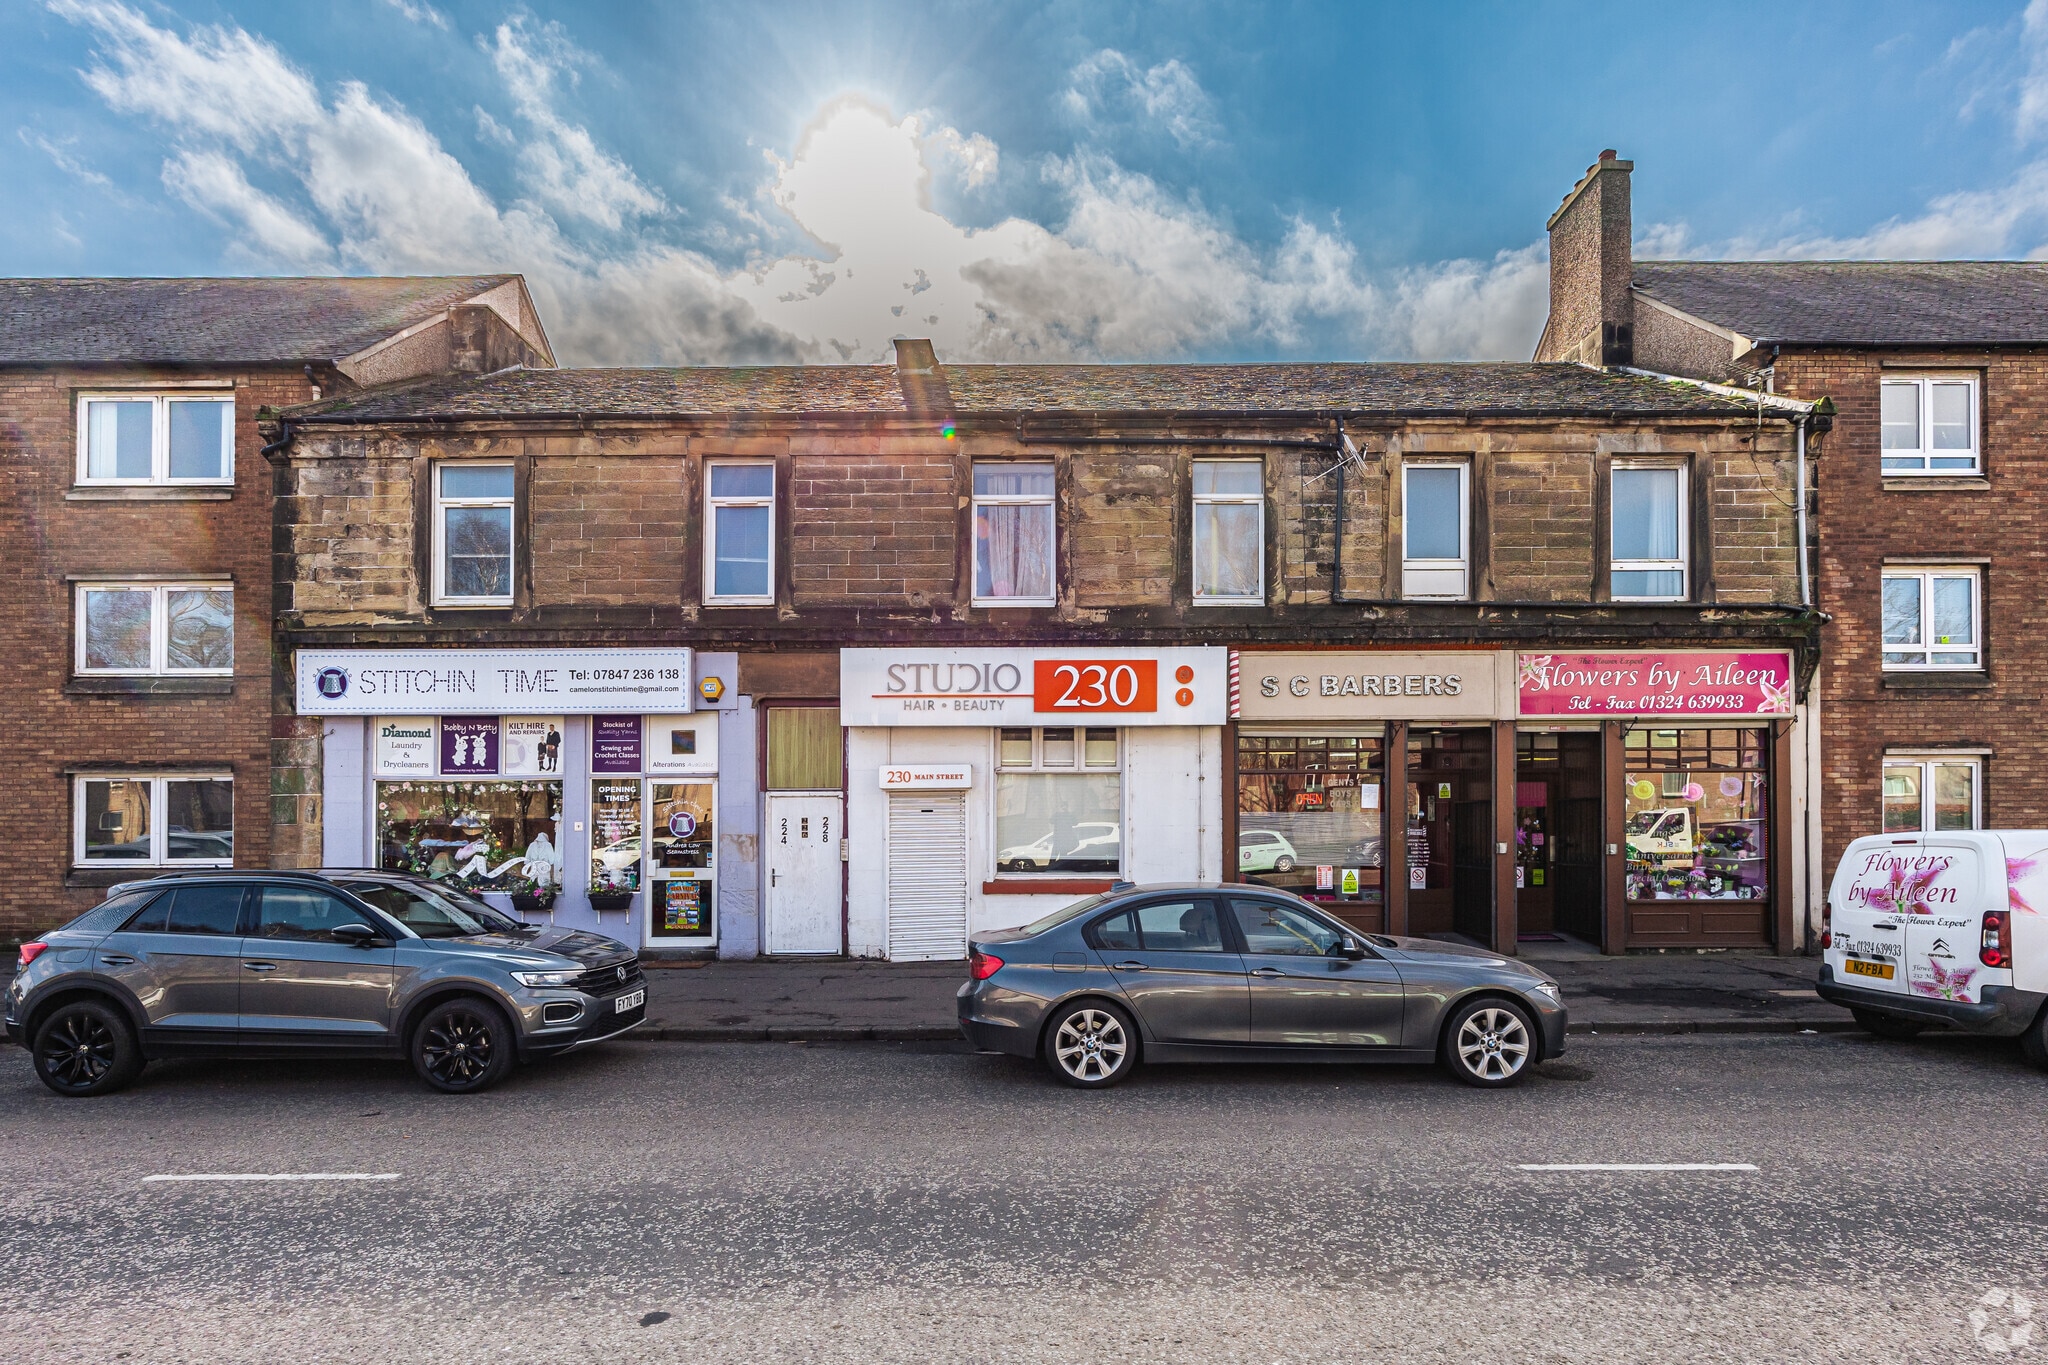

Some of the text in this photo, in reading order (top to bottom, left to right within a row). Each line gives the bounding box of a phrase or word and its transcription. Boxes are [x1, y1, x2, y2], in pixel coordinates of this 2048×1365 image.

[1592, 656, 1618, 665] Flower
[568, 669, 680, 680] Tel: 07847 236 138
[887, 663, 1022, 693] STUDIO
[1530, 661, 1778, 694] Flowers by Aileen
[359, 669, 558, 695] STITCHIN TIME
[1053, 664, 1139, 707] 230
[1260, 674, 1463, 697] S C BARBERS
[569, 685, 680, 694] camelonstitchintime@gmail.com
[903, 700, 1005, 711] HAIR BEAUTY
[1568, 695, 1592, 710] Tel
[1605, 695, 1636, 710] Fax
[1639, 694, 1684, 710] 01324
[1688, 694, 1745, 709] 639933
[381, 724, 432, 738] Diamond
[443, 724, 467, 735] Bobby
[476, 724, 498, 735] Betty
[508, 722, 545, 730] KILT HIRE
[391, 741, 422, 750] Laundry
[383, 761, 429, 769] Drycleaners
[887, 770, 912, 784] 230
[1327, 778, 1354, 787] GENTS
[1295, 793, 1323, 805] OPEN
[1329, 789, 1352, 798] BOYS
[1858, 850, 1954, 877] Flowers
[1847, 879, 1958, 909] by Aileen
[1907, 916, 1935, 926] Flower
[1875, 943, 1902, 957] 639933
[1853, 961, 1883, 976] N2 FBA
[618, 996, 632, 1011] FY70
